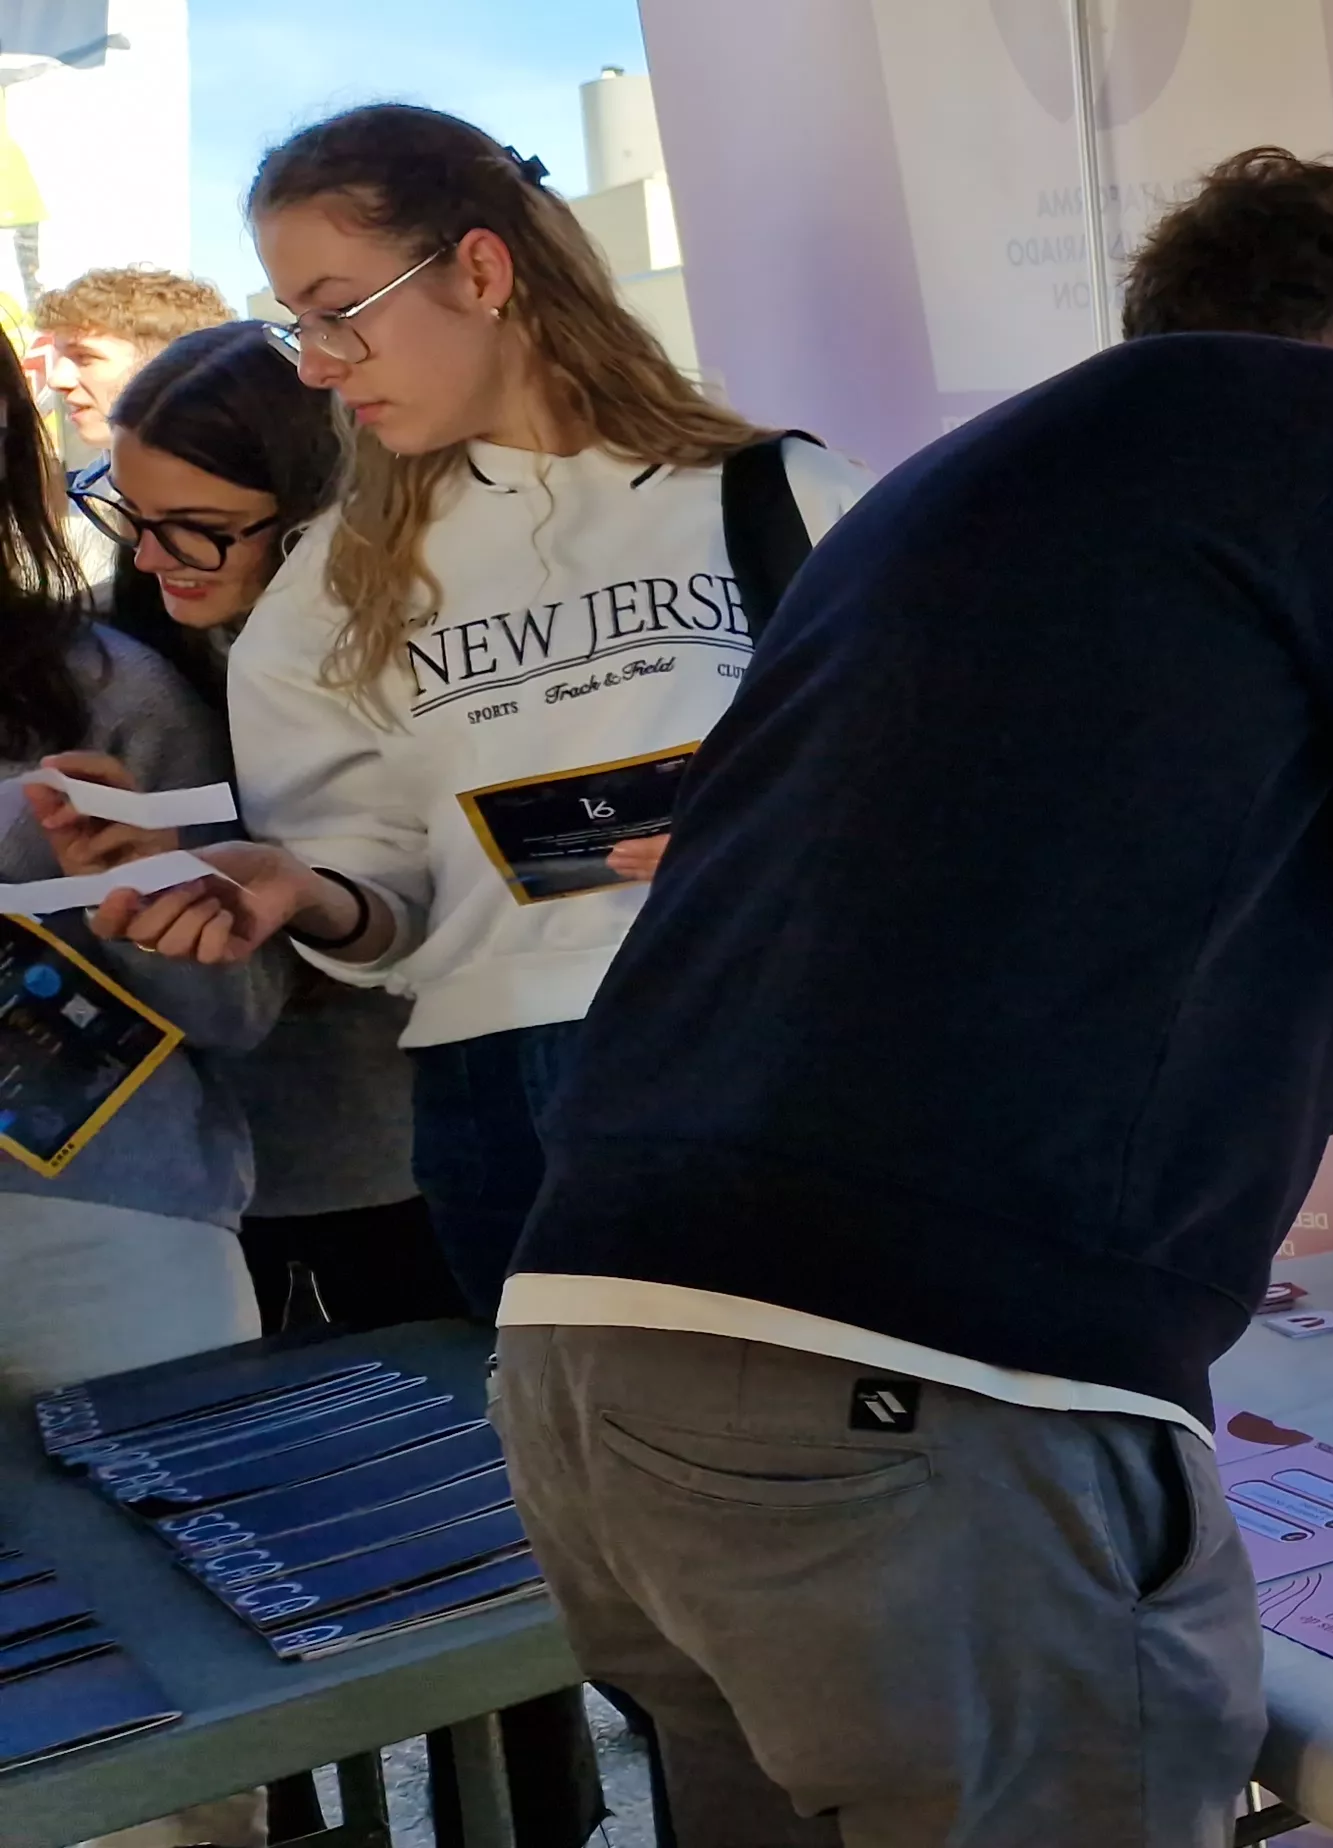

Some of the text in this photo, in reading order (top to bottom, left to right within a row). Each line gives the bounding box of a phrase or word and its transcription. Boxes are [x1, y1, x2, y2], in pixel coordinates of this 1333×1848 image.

[405, 572, 753, 697] NEW JERSE
[544, 675, 602, 705] Track
[622, 656, 677, 682] Field
[467, 700, 519, 725] SPORTS
